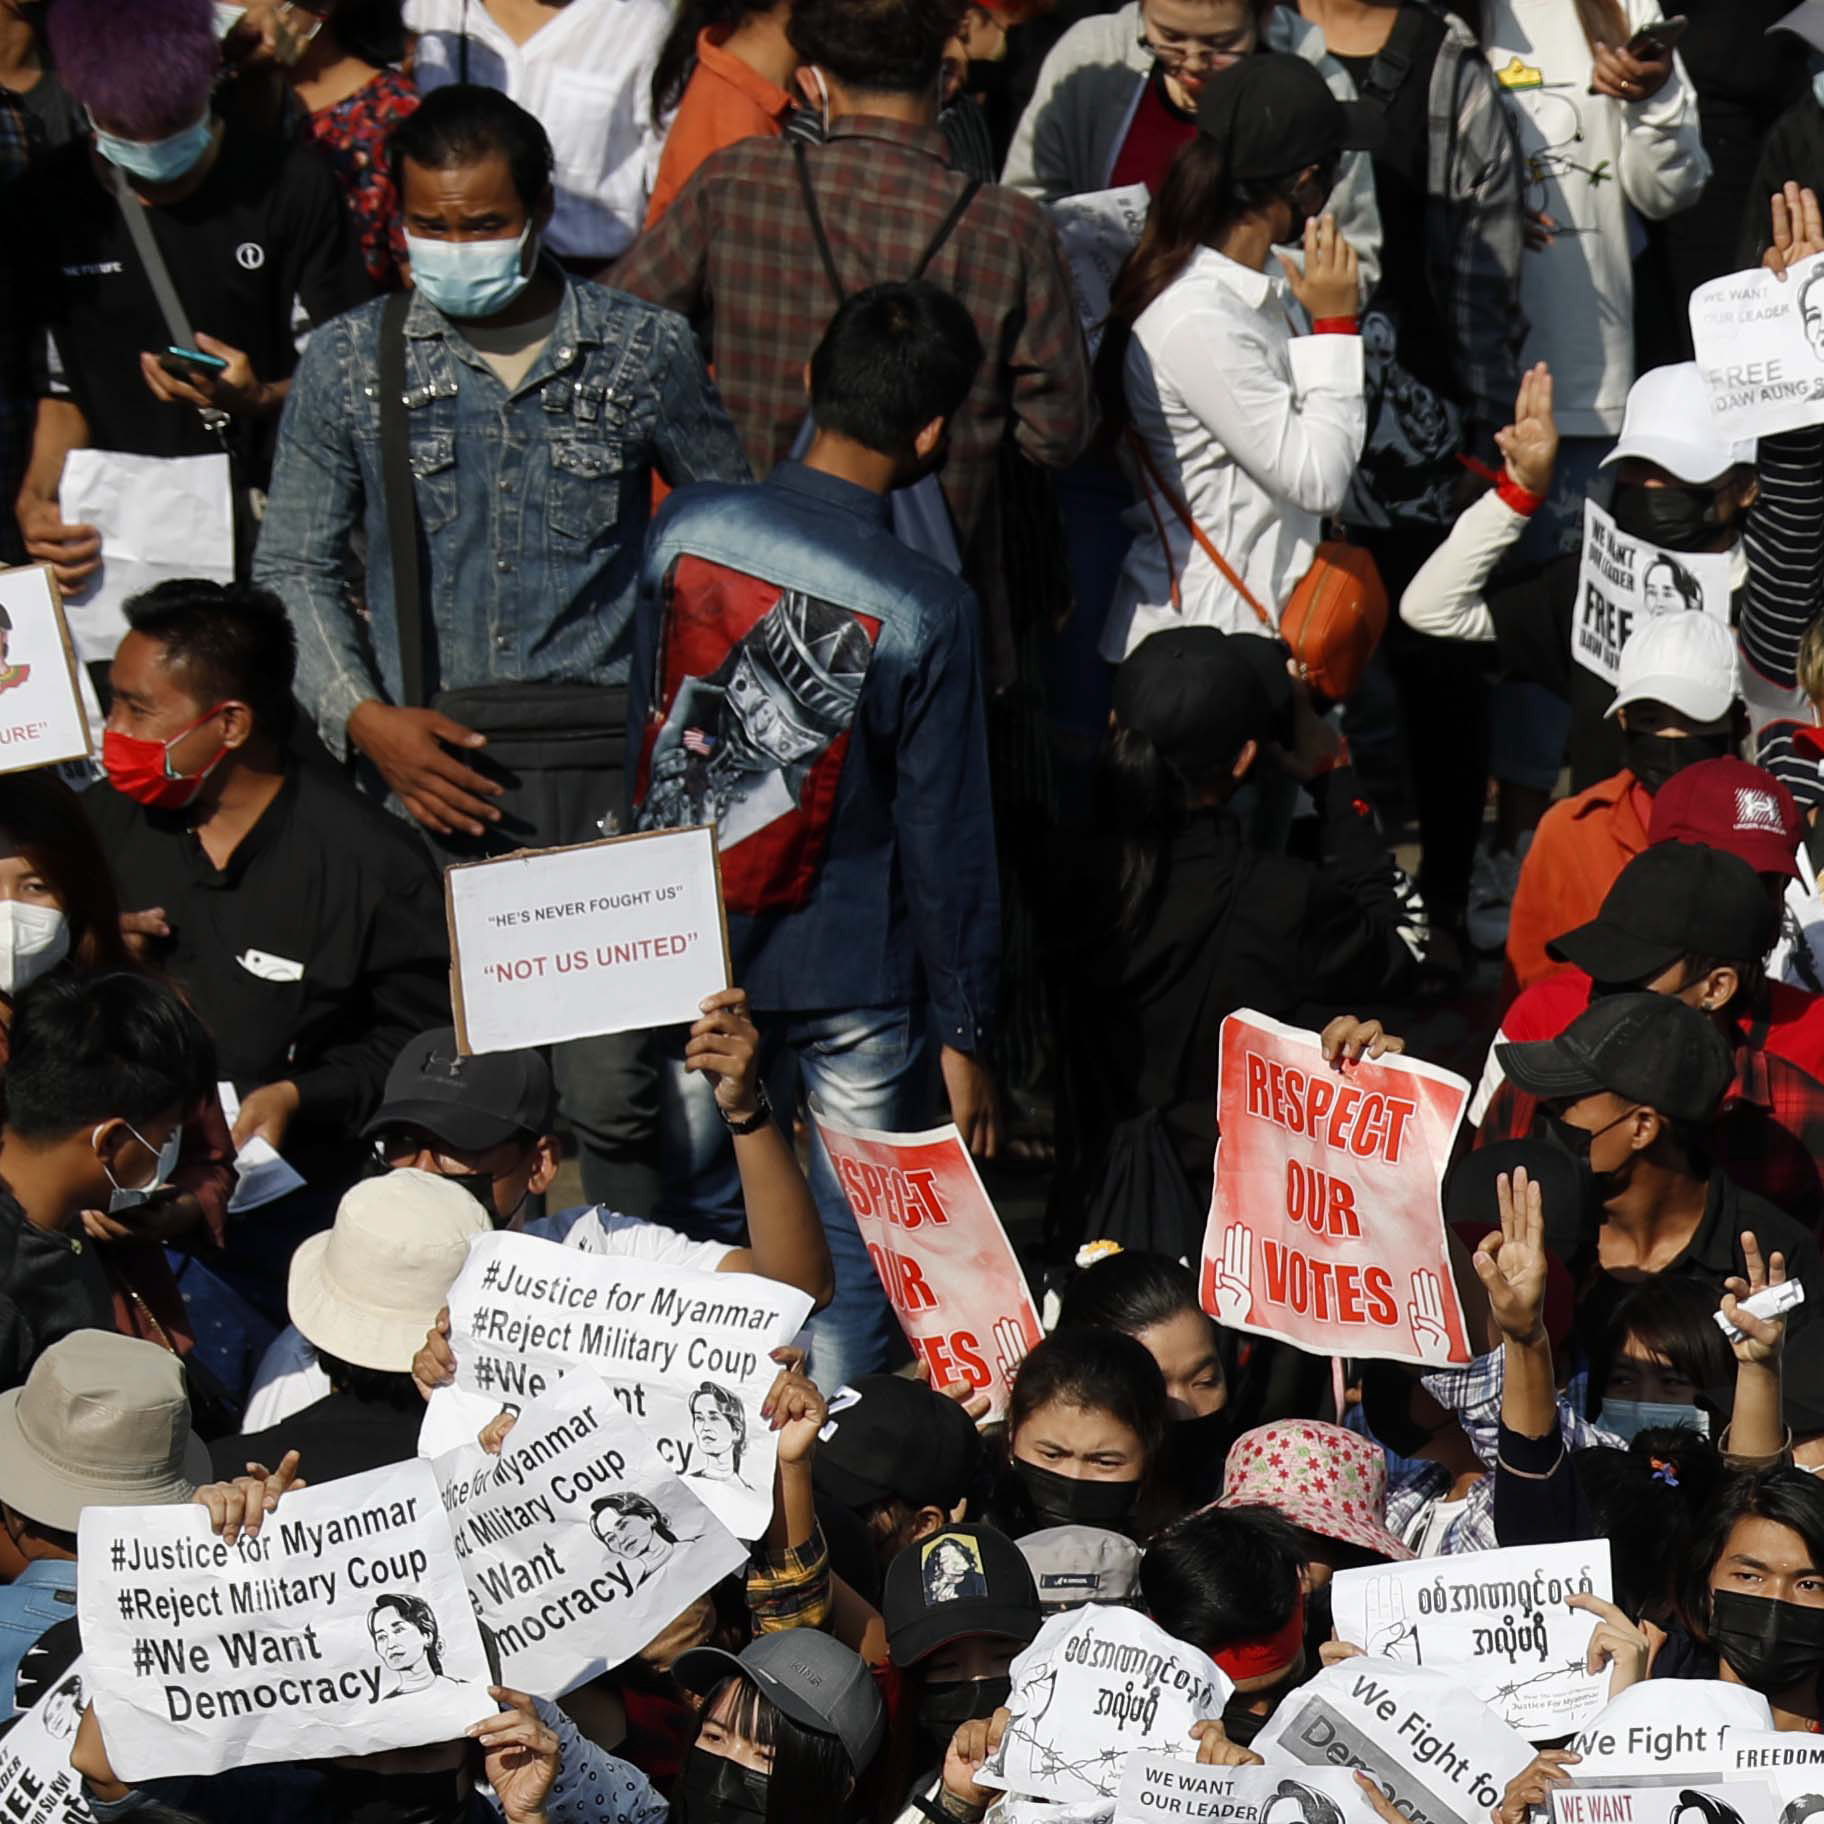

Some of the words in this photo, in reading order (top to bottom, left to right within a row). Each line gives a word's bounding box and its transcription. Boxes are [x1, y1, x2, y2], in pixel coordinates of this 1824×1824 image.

[1242, 1051, 1416, 1165] RESPECT
[1286, 1158, 1361, 1239] OUR
[484, 1261, 597, 1310] #Justice
[606, 1284, 642, 1312] for
[651, 1288, 780, 1333] Myanmar
[1260, 1238, 1400, 1327] VOTES
[471, 1308, 573, 1353] #Reject
[579, 1324, 677, 1372] Military
[687, 1338, 757, 1380] Coup
[474, 1356, 546, 1396] #We
[110, 1536, 228, 1573] #Justice
[238, 1535, 270, 1565] for
[280, 1496, 419, 1556] Myanmar
[472, 1486, 551, 1553] Military
[550, 1449, 626, 1504] Coup
[118, 1587, 222, 1624] #Reject
[230, 1568, 336, 1615] Military
[345, 1545, 428, 1593] Coup
[476, 1544, 566, 1615] Want
[132, 1634, 210, 1677] #We
[219, 1627, 323, 1671] Want
[165, 1662, 383, 1723] Democracy
[1351, 1674, 1397, 1721] We
[1397, 1713, 1471, 1788] Fight
[1140, 1791, 1180, 1810] OUR
[1184, 1797, 1258, 1822] LEADER
[1145, 1767, 1176, 1784] WE
[1178, 1774, 1234, 1797] WANT
[1561, 1797, 1585, 1823] WE
[1586, 1795, 1633, 1823] WANT
